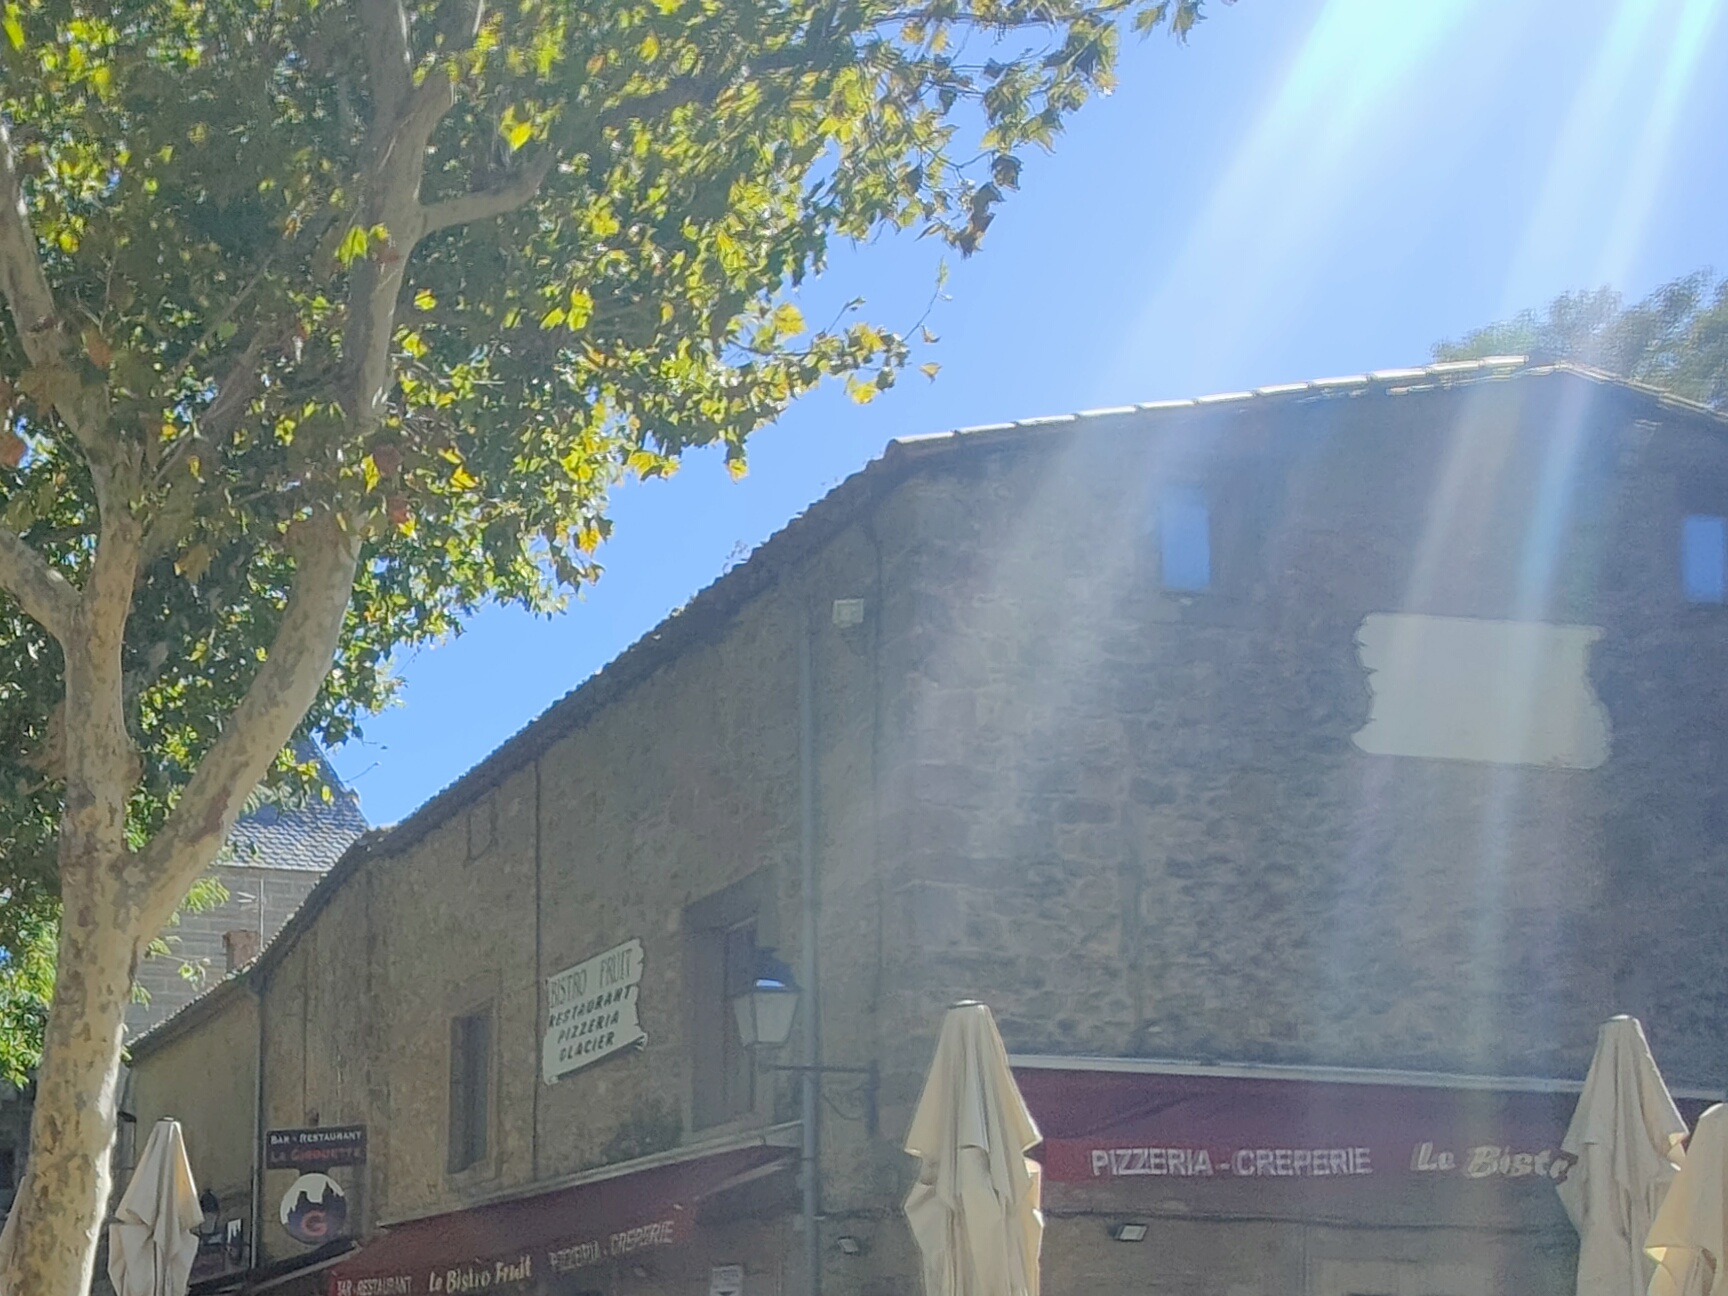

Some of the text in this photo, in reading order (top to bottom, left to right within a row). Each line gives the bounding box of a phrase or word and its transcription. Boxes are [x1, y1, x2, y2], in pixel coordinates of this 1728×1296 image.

[548, 984, 633, 1028] RESTAURANT
[557, 1009, 620, 1044] PIZZERIA
[559, 1031, 616, 1062] GLACIER
[1090, 1148, 1214, 1177] PIZZERIA
[1233, 1147, 1373, 1177] CREPERIE
[1462, 1144, 1571, 1182] Bistr
